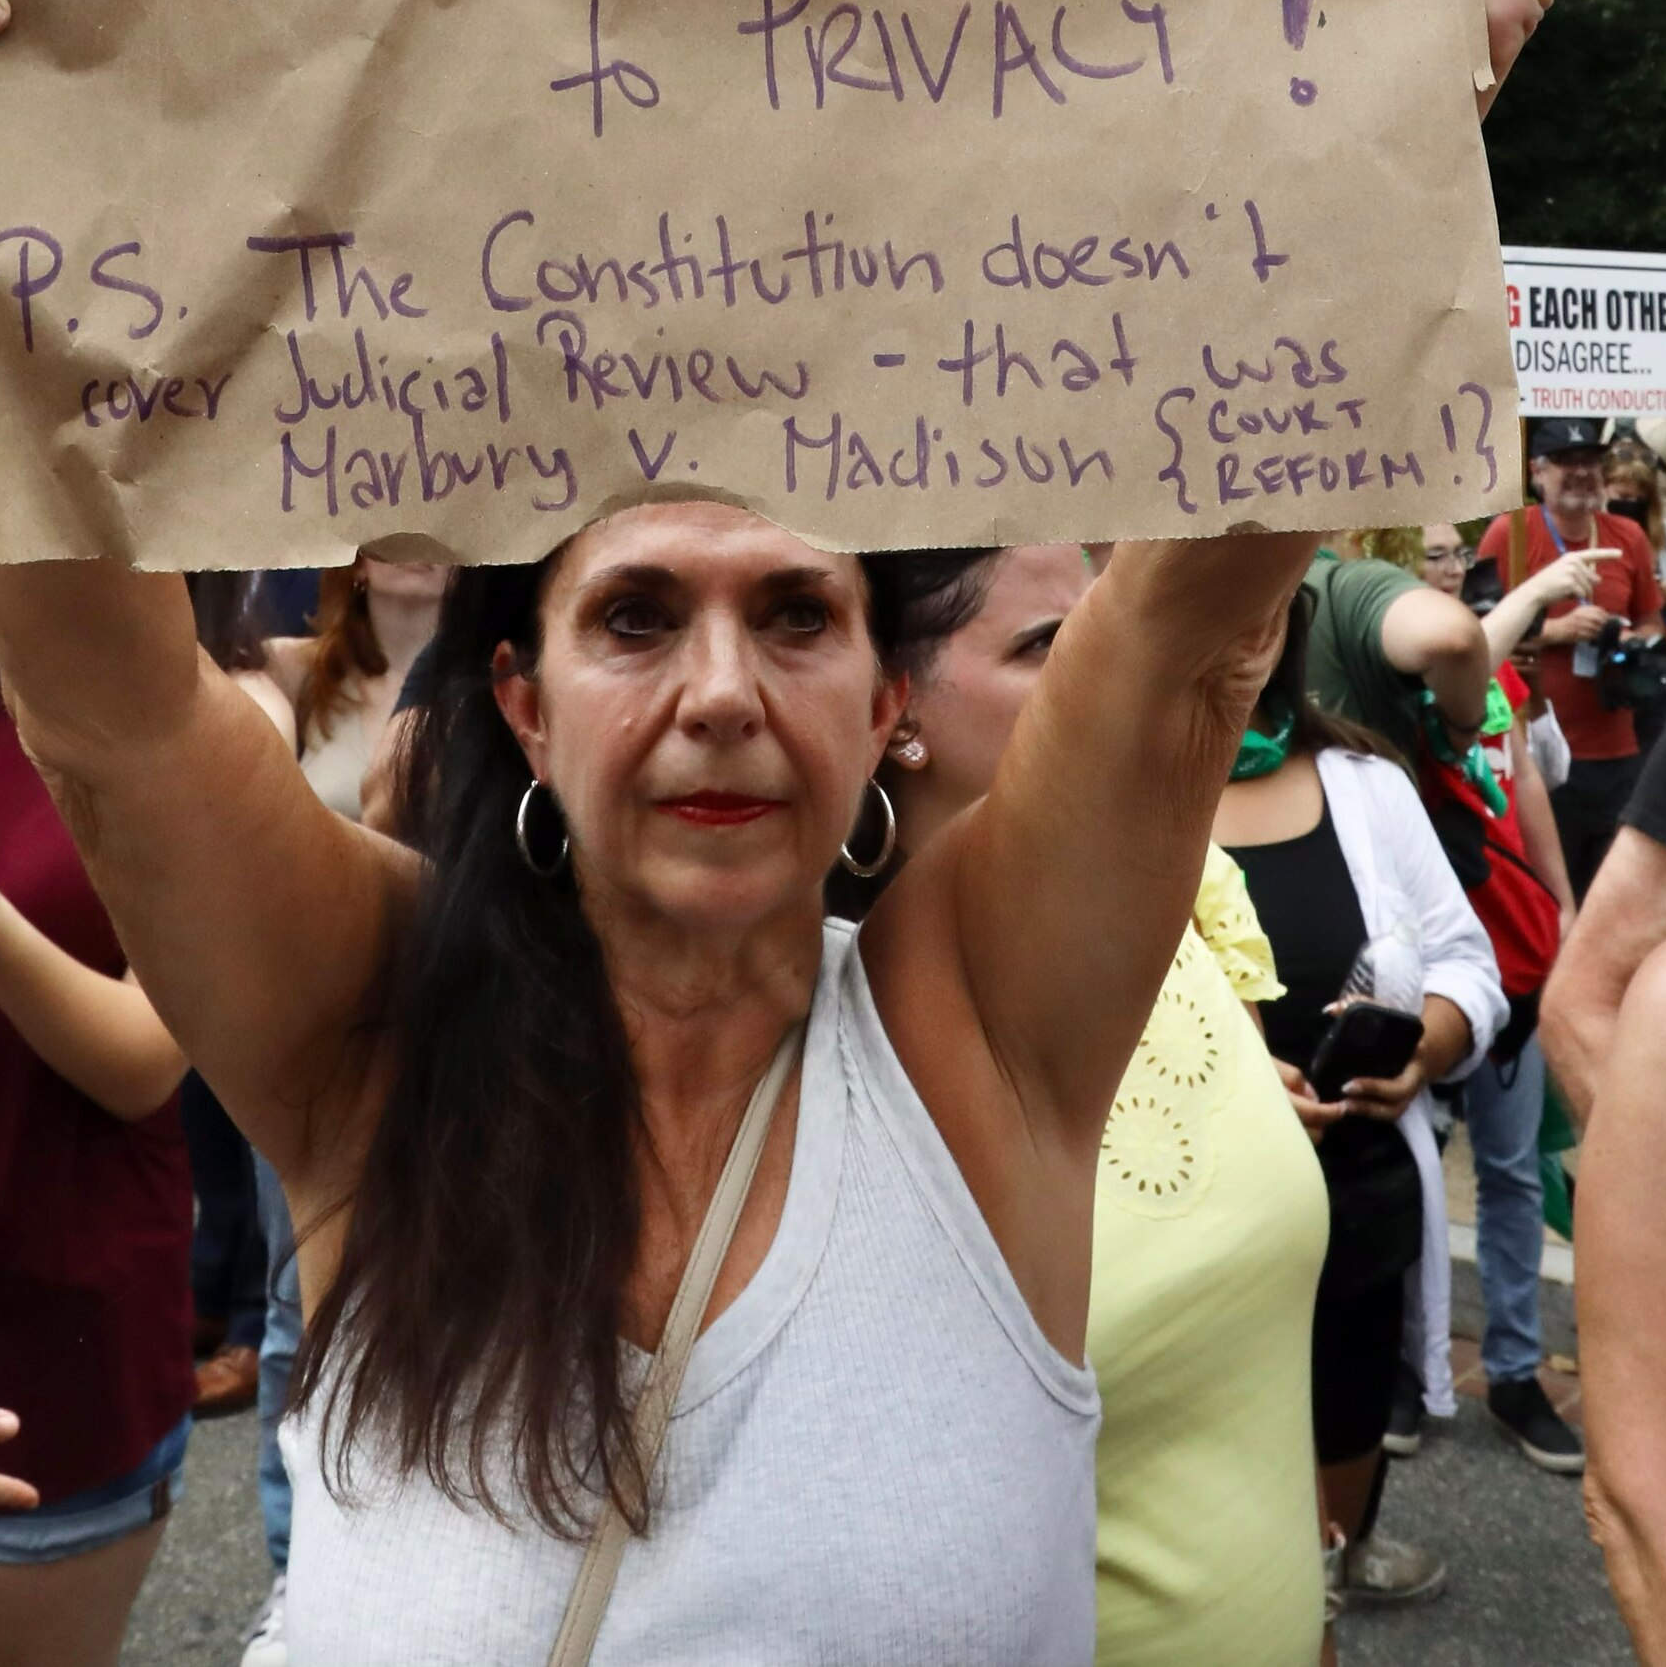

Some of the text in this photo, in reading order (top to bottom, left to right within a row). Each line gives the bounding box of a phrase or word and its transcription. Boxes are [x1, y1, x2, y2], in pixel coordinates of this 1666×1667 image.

[246, 231, 430, 322] The
[482, 209, 944, 313] Constitution
[981, 199, 1290, 290] doesn't
[1529, 286, 1598, 331] EACH
[81, 371, 231, 428] cover
[274, 327, 511, 424] Judicial
[536, 309, 810, 410] Review
[936, 311, 1139, 407] that
[1202, 336, 1348, 390] was
[1515, 339, 1653, 376] DISAGREE...
[1531, 387, 1584, 410] TRUTH
[280, 413, 579, 517] Marbury
[783, 411, 1115, 502] Madison
